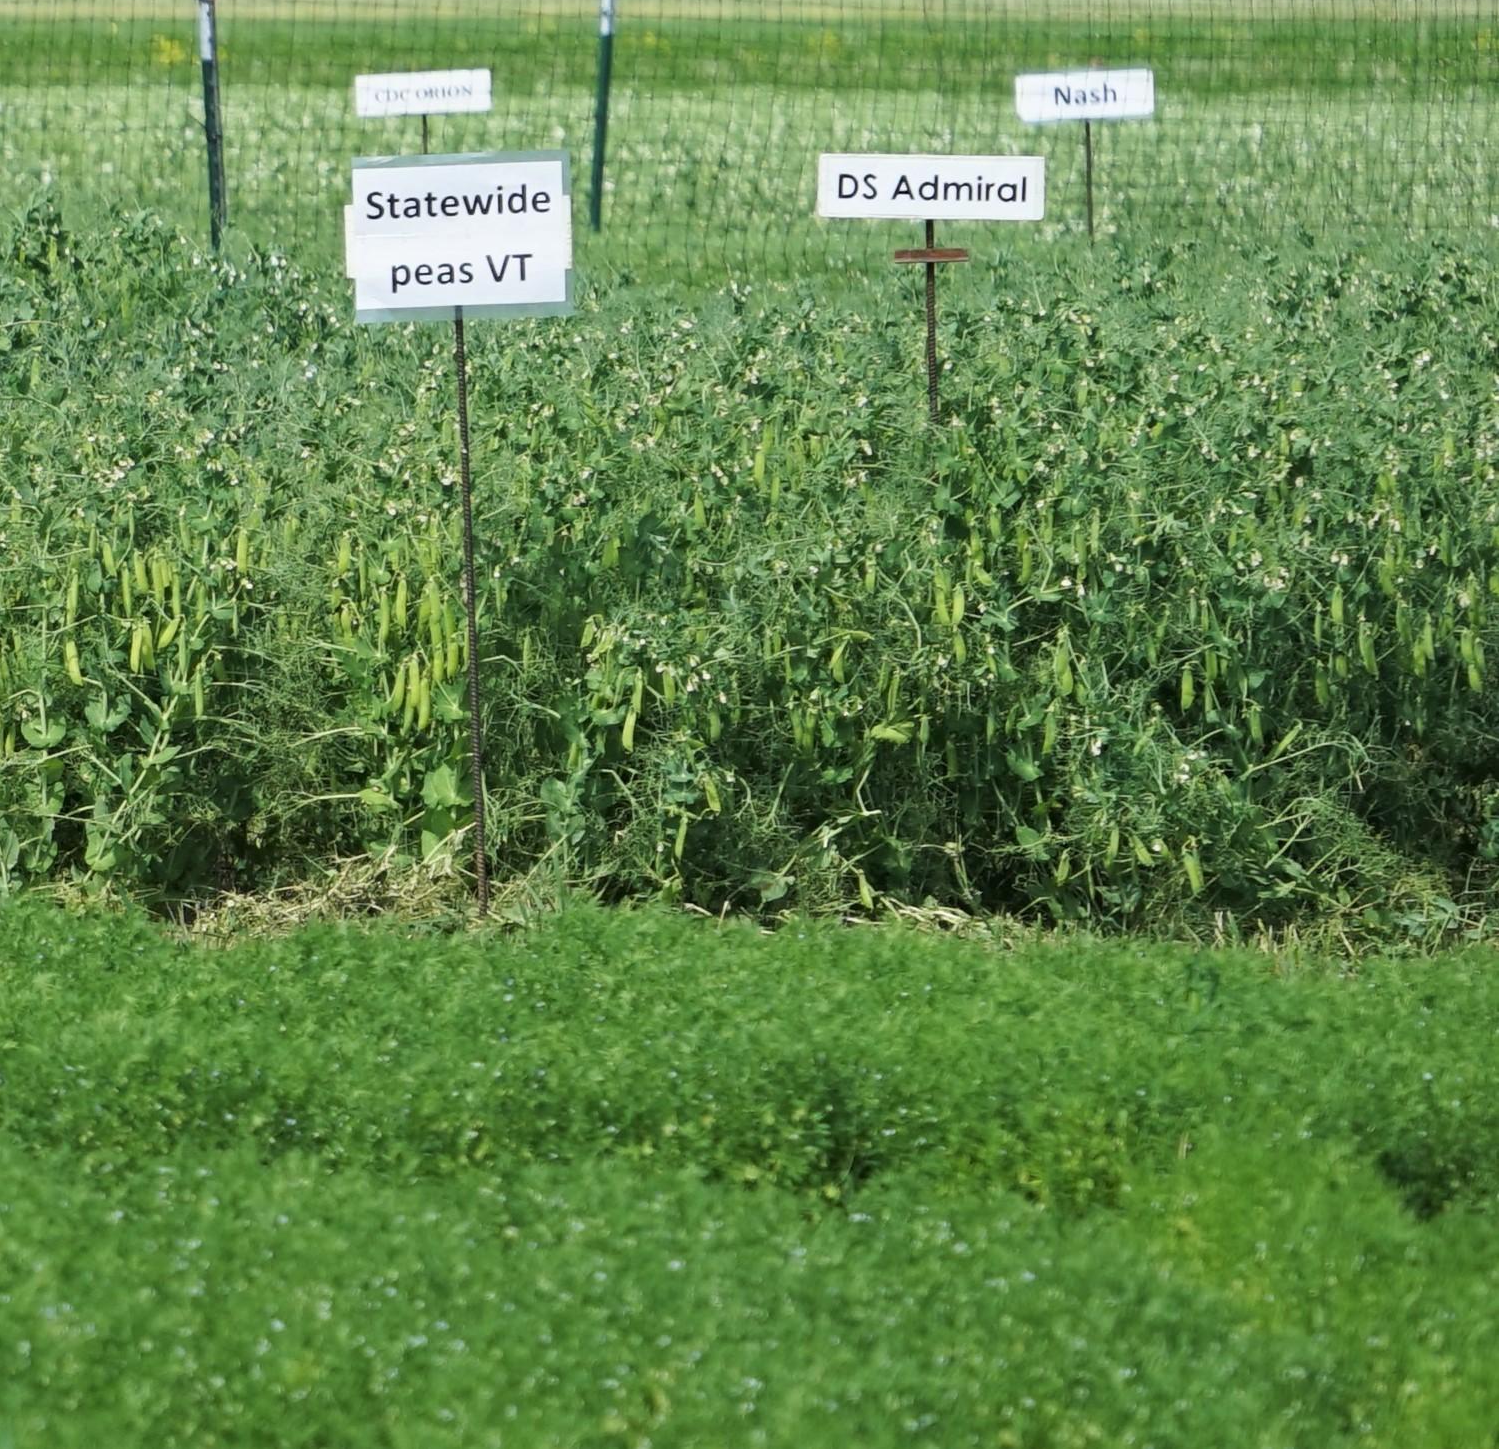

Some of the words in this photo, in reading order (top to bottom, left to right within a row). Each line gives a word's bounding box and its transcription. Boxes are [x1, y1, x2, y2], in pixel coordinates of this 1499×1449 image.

[1054, 82, 1118, 106] Nash
[365, 183, 552, 220] Statewide
[837, 173, 879, 200] DS
[890, 174, 1028, 203] Admiral
[390, 262, 475, 294] peas
[485, 253, 534, 283] VT
